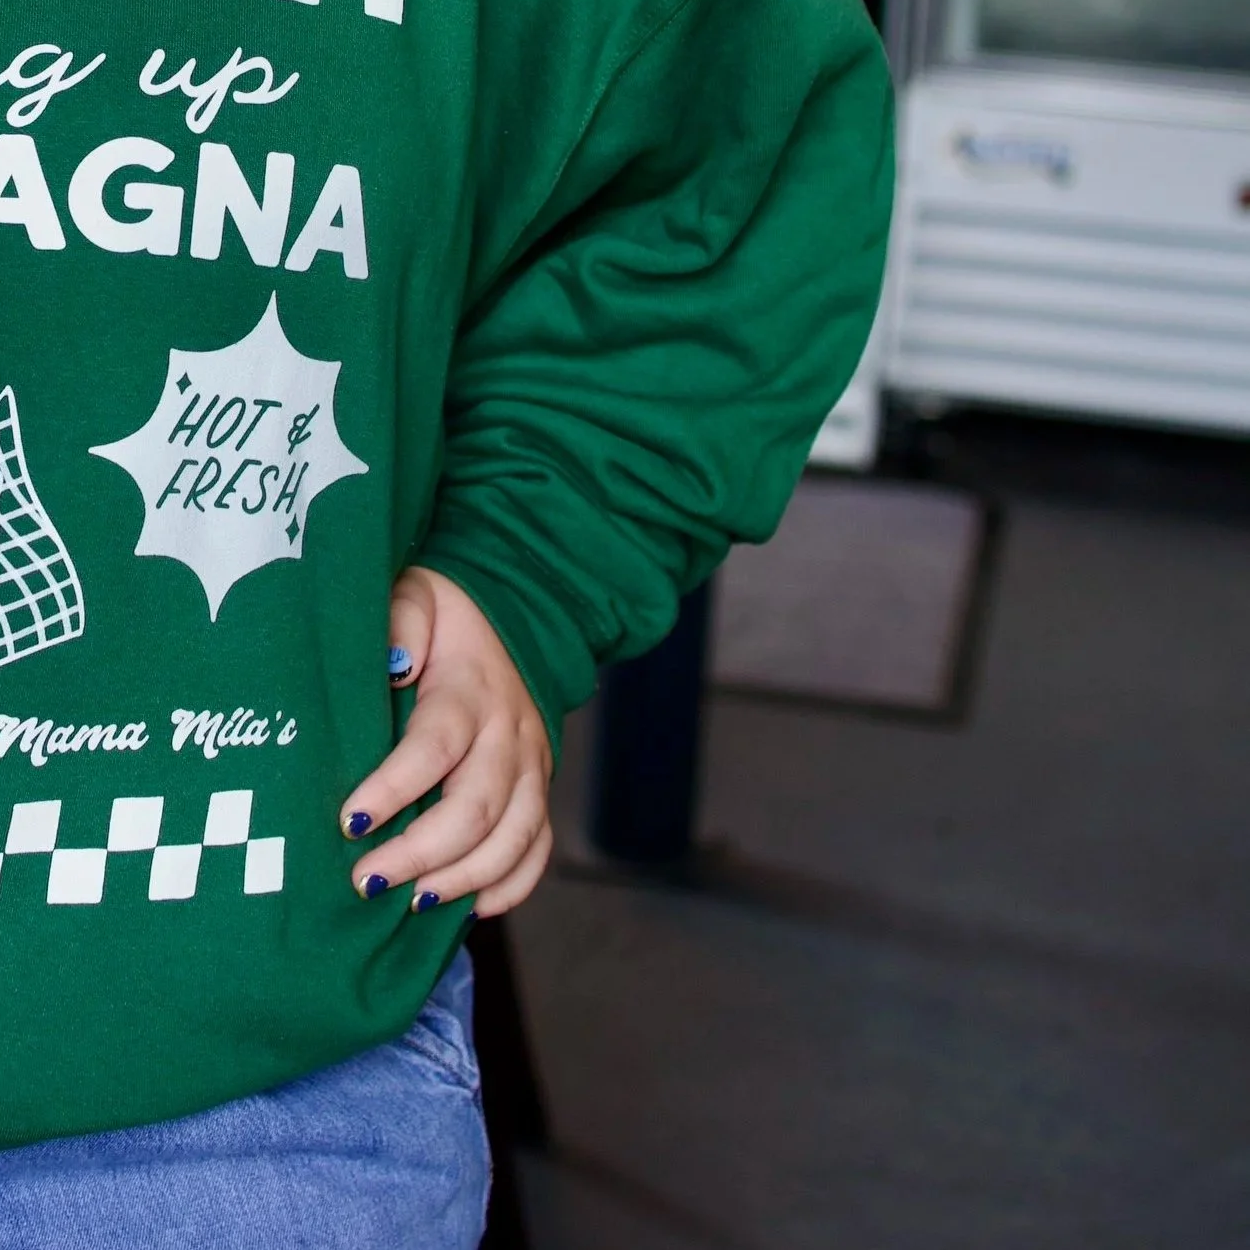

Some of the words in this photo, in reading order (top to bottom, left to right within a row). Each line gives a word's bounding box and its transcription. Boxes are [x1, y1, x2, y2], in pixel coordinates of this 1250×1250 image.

[138, 46, 300, 134] up
[166, 392, 283, 452] HOT
[287, 402, 321, 456] &
[155, 456, 310, 515] FRESH
[170, 706, 298, 760] Mila's
